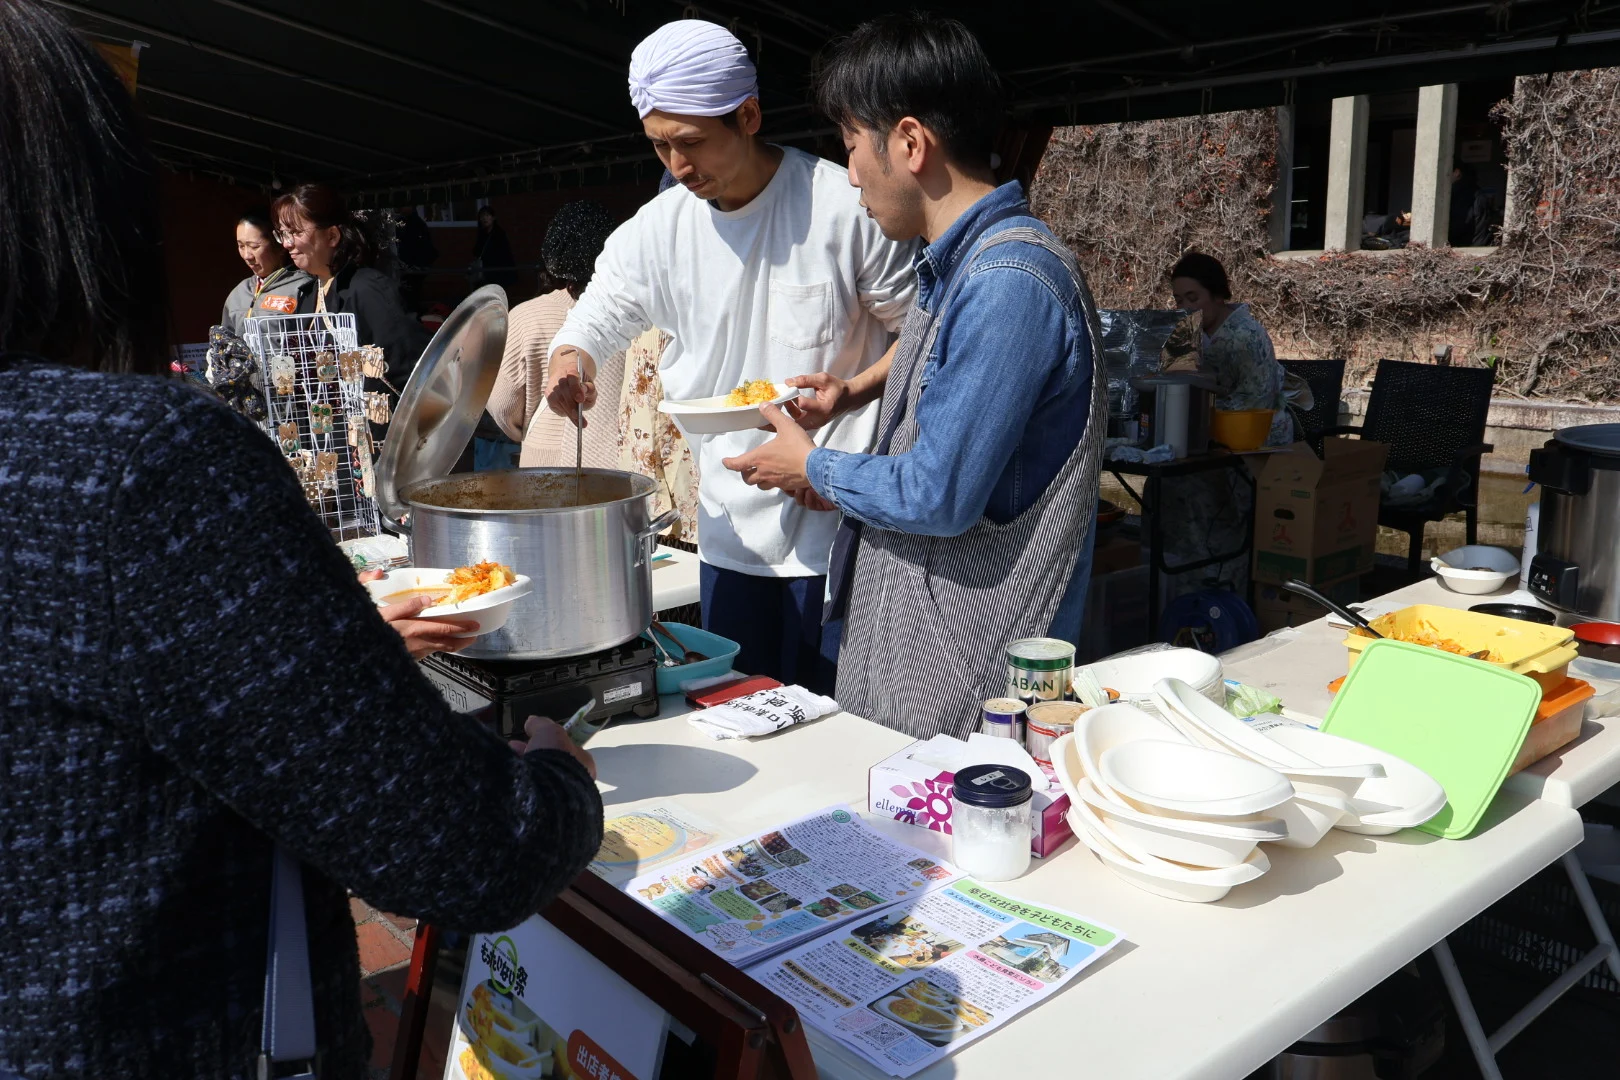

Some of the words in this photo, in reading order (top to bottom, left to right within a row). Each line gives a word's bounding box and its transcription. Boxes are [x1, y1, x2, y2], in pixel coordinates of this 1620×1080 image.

[968, 887, 1097, 939] 幸せな社会を子どもたちに
[481, 942, 528, 998] もったいない祭
